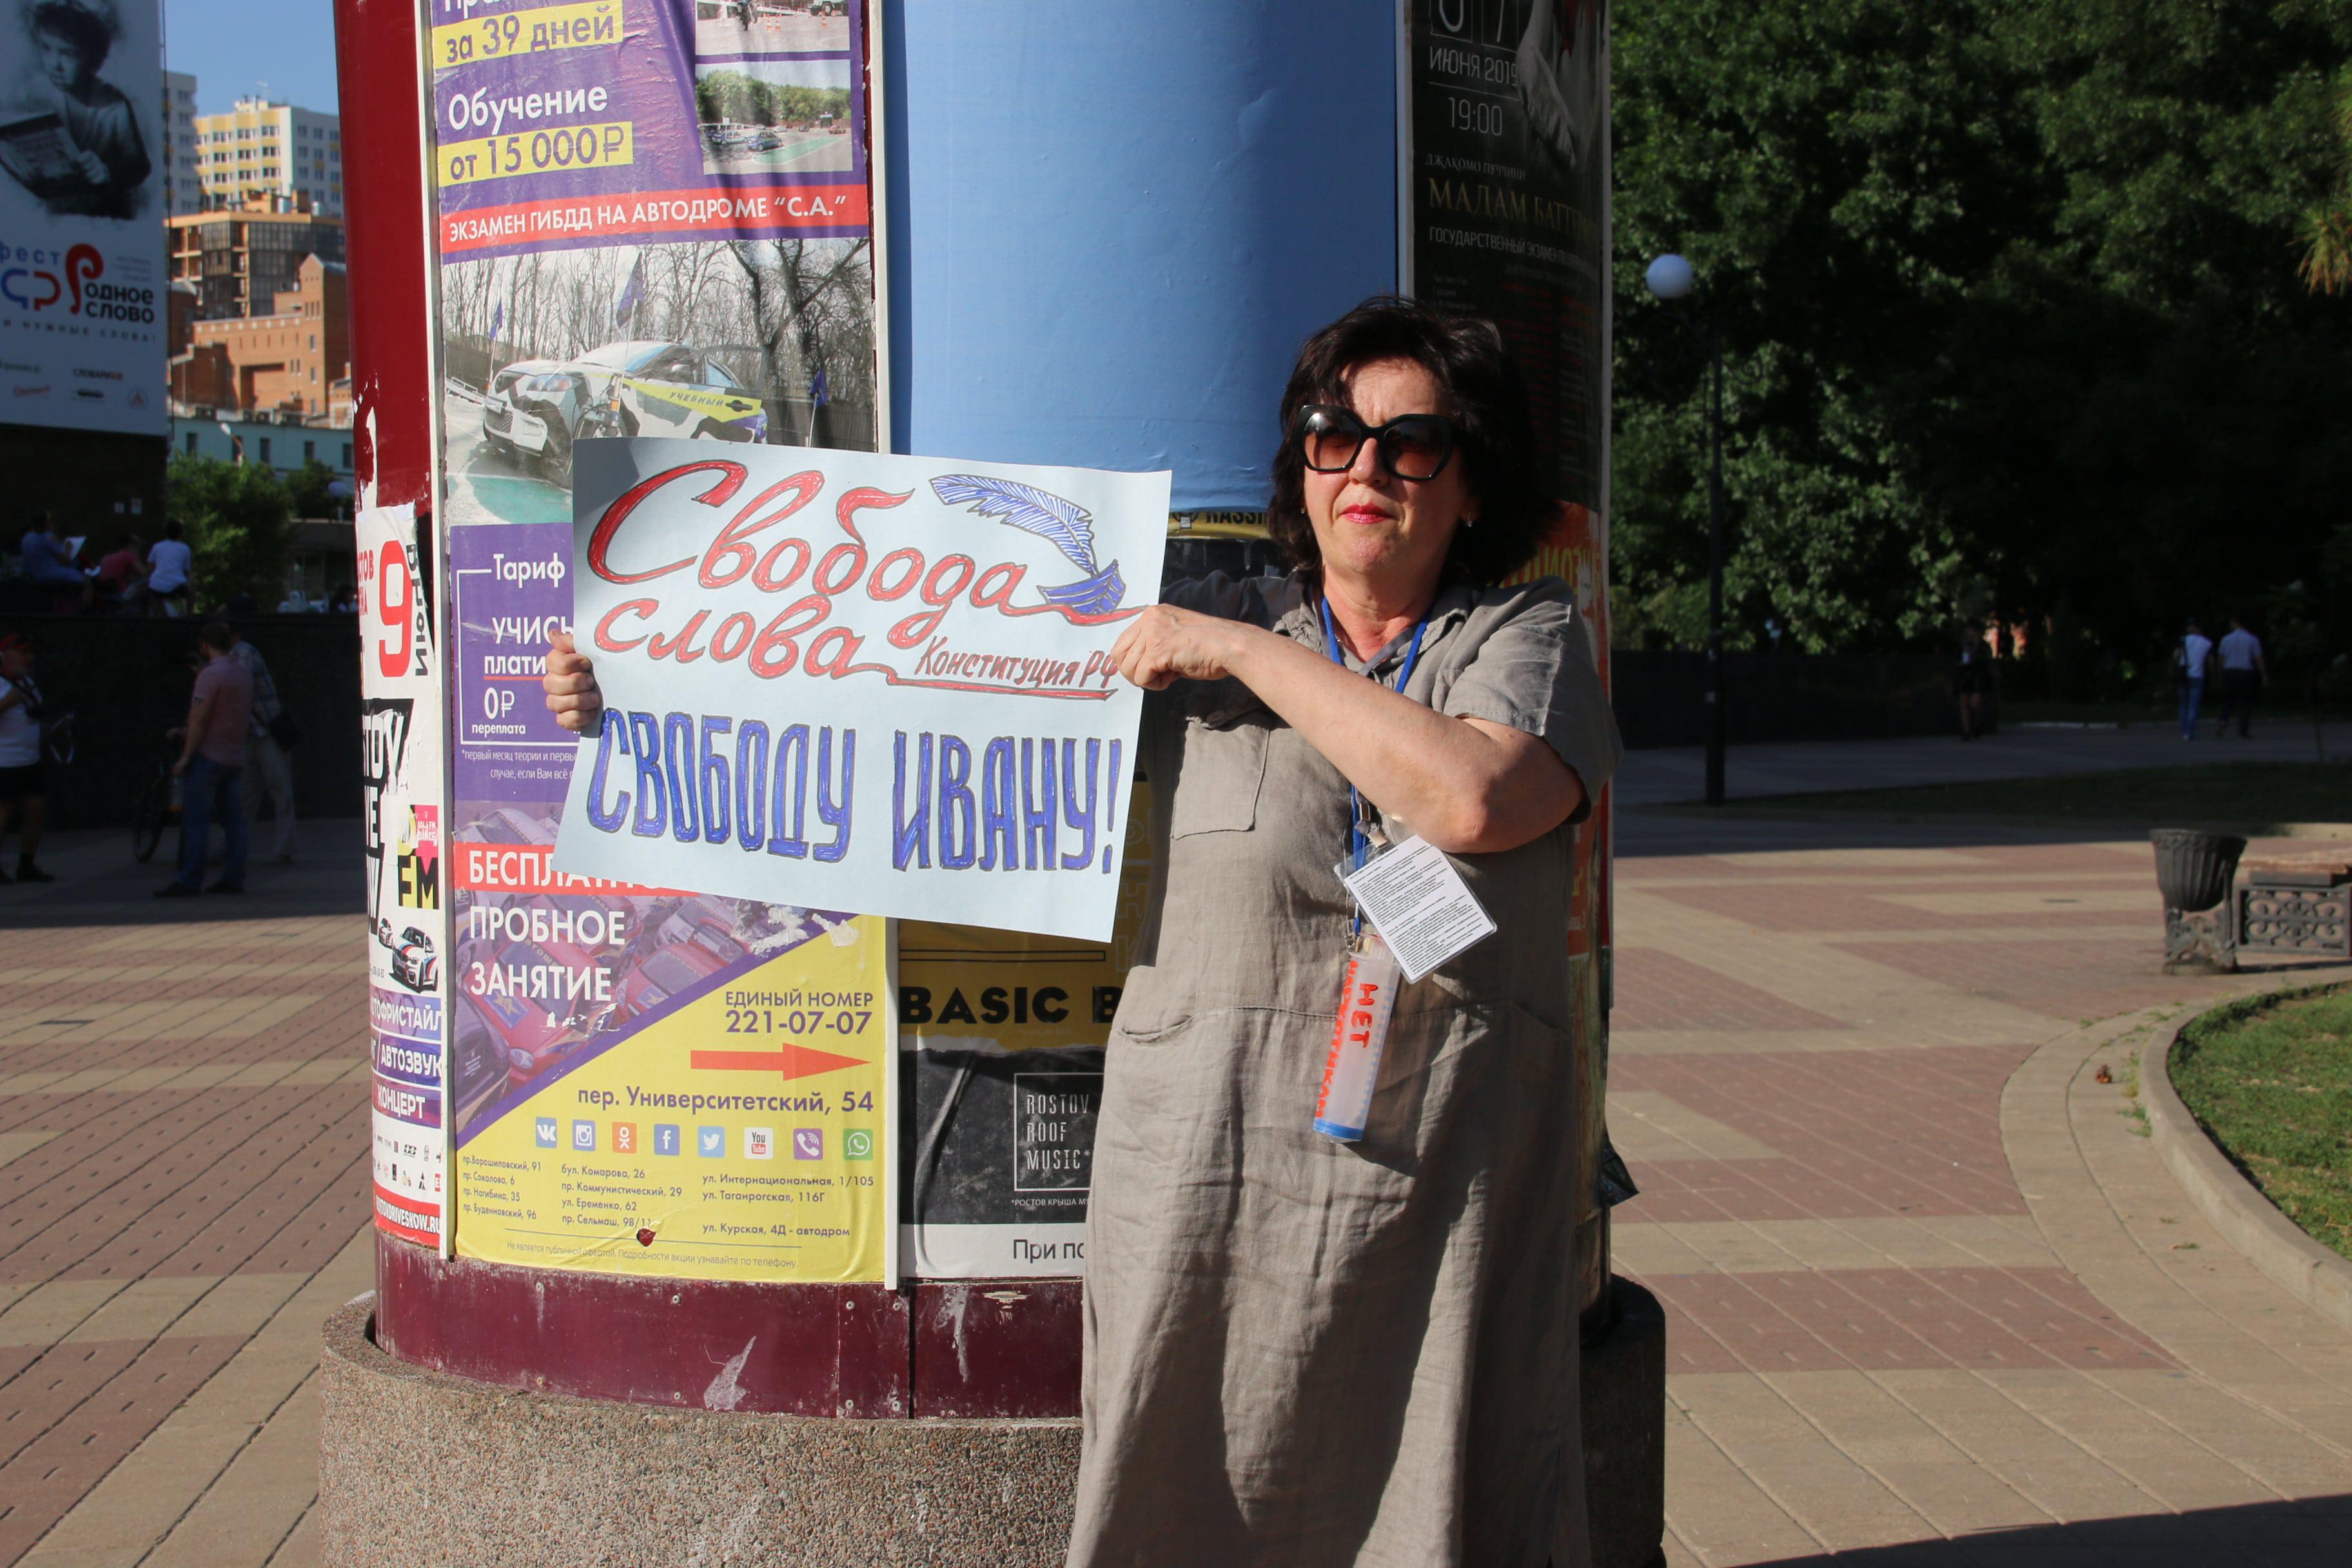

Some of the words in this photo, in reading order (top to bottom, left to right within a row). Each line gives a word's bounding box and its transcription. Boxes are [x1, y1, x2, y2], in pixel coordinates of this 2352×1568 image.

[447, 35, 473, 63] за
[483, 15, 520, 55] 39
[531, 5, 614, 53] дней
[1430, 46, 1480, 78] ИЮНЯ
[1485, 57, 1518, 86] 2019
[449, 86, 608, 135] Обучение
[1449, 97, 1502, 136] 19:00
[451, 155, 478, 181] от
[488, 137, 522, 174] 15
[1424, 153, 1481, 172] ДЖАКОМО
[1428, 177, 1527, 222] МАДАМ
[449, 213, 526, 242] ЭКЗАМЕН
[530, 206, 594, 233] ГИБДД
[598, 203, 627, 225] НА
[632, 196, 767, 223] АВТОДРОМЕ
[669, 391, 724, 407] УЧЕБНЫЙ
[588, 459, 1083, 646] Свобода
[493, 552, 566, 588] Тариф
[379, 540, 413, 677] 9
[594, 594, 897, 680] слова
[914, 635, 1077, 688] Конституция
[1079, 649, 1120, 689] РФ
[471, 723, 526, 738] переплата
[515, 752, 542, 763] теории
[542, 752, 548, 761] и
[490, 768, 516, 781] случае,
[517, 770, 535, 779] если
[536, 767, 553, 779] Вам
[587, 707, 856, 863] СВОБОДУ
[892, 730, 1122, 874] ИВАНУ!
[469, 905, 625, 946] ПРОБНОЕ
[470, 961, 612, 1001] ЗАНЯТИЕ
[725, 988, 804, 1010] ЕДИНЫЙ
[808, 992, 873, 1008] НОМЕР
[899, 986, 1070, 1024] BASIC
[725, 1010, 873, 1035] 221-07-07
[1349, 983, 1378, 1048] НЕТ
[378, 1084, 426, 1119] КОНЦЕРТ
[579, 1089, 620, 1111] пер.
[627, 1086, 832, 1115] Университетский,
[841, 1092, 873, 1112] 54
[1026, 1093, 1090, 1115] ROSTOV
[751, 1132, 766, 1144] You
[1026, 1121, 1068, 1142] ROOF
[750, 1144, 766, 1155] Tube
[532, 1162, 541, 1171] 91
[562, 1164, 579, 1176] бул.
[582, 1166, 630, 1179] Комарова,
[633, 1168, 645, 1179] 26
[463, 1172, 472, 1181] пр.
[474, 1171, 508, 1186] Соколова,
[510, 1175, 515, 1185] 6
[562, 1182, 574, 1193] пр.
[577, 1181, 667, 1197] Коммунистический,
[669, 1187, 682, 1197] 29
[703, 1175, 717, 1184] ул.
[720, 1173, 835, 1188] Интернациональная,
[840, 1175, 874, 1188] 1/105
[463, 1188, 472, 1197] пр.
[474, 1187, 508, 1202] Нагибина,
[511, 1191, 520, 1202] 35
[562, 1199, 574, 1208] ул.
[576, 1198, 622, 1212] Еременко,
[625, 1201, 637, 1211] 62
[703, 1191, 717, 1201] ул.
[720, 1190, 794, 1203] Таганрогская,
[799, 1192, 825, 1202] 116Г
[1048, 1198, 1077, 1206] КРЫША
[463, 1203, 472, 1213] пр.
[474, 1203, 524, 1220] Буденновский,
[527, 1209, 536, 1220] 96
[562, 1215, 574, 1225] пр.
[577, 1214, 619, 1228] Сельмаш,
[703, 1225, 717, 1234] ул.
[720, 1223, 767, 1236] Курская,
[770, 1225, 787, 1236] 4Д
[796, 1227, 850, 1238] автодром
[618, 1250, 669, 1262] Подробности
[671, 1254, 696, 1264] акции
[697, 1255, 738, 1266] узнавайте
[1014, 1240, 1057, 1263] При
